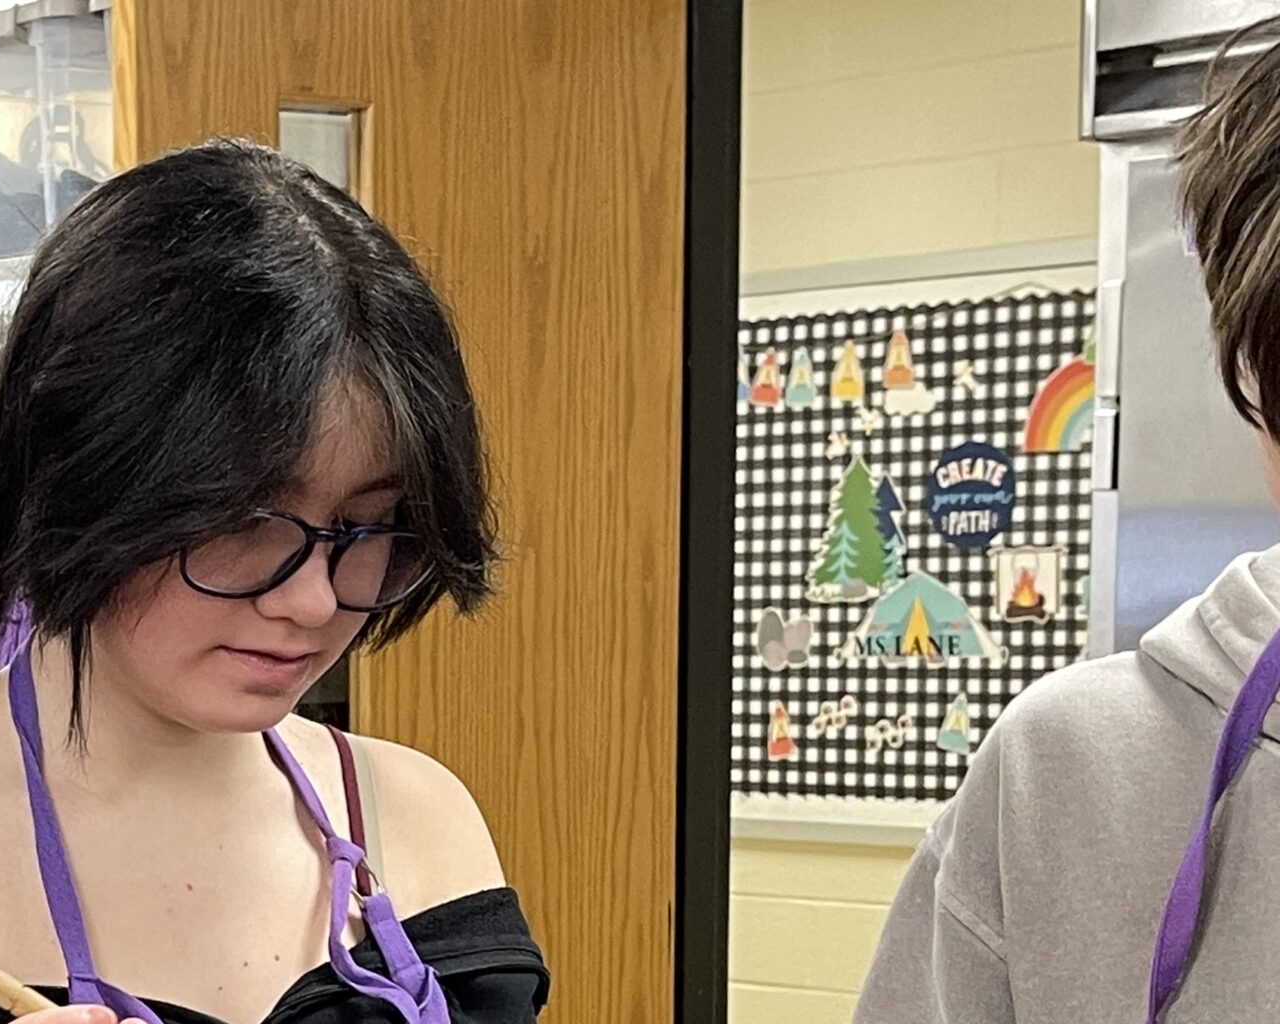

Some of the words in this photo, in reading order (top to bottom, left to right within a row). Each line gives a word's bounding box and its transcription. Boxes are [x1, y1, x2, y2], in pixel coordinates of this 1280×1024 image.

[936, 457, 1008, 489] CREATE
[932, 493, 971, 512] your
[948, 509, 991, 536] PATH
[854, 635, 887, 656] MS
[894, 635, 962, 656] LANE
